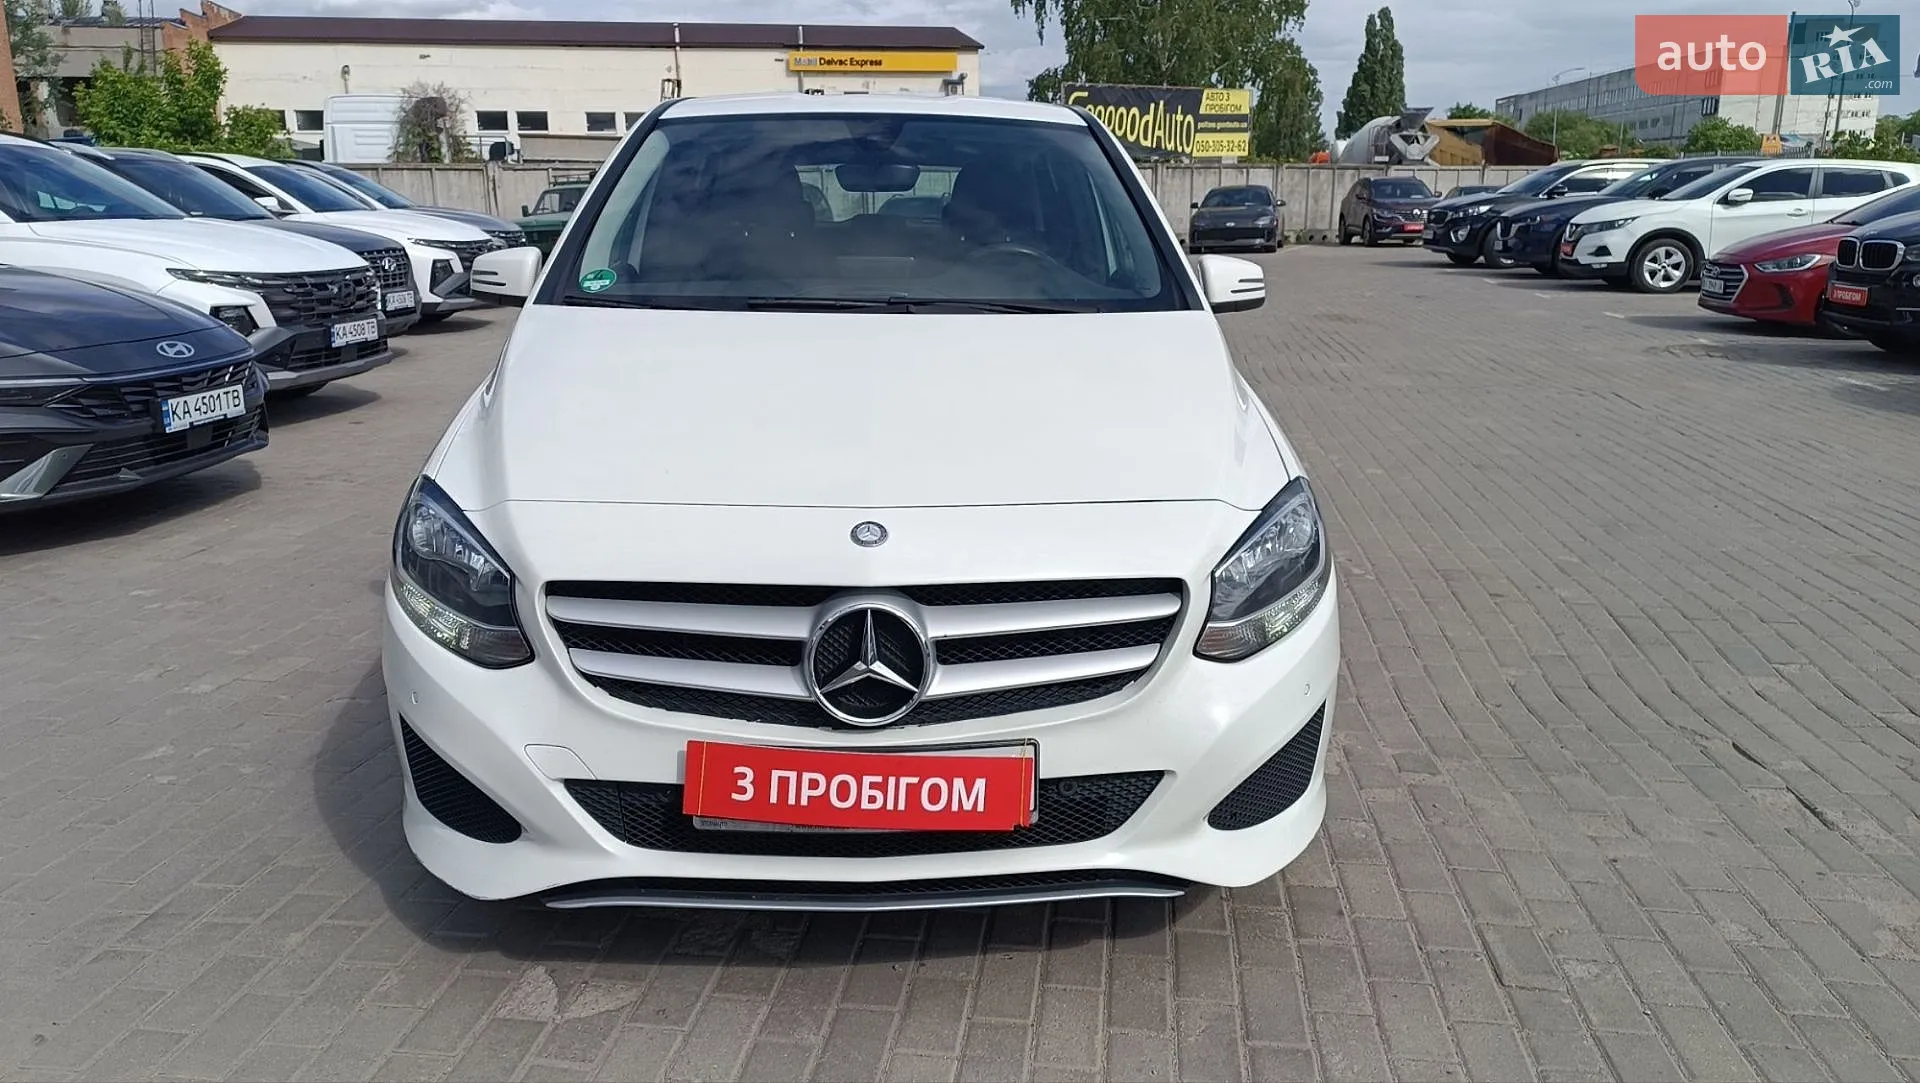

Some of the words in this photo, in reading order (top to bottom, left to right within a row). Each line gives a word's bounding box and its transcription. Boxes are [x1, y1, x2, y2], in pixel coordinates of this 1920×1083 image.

[819, 57, 848, 66] Delvac
[849, 57, 883, 68] Express
[170, 400, 192, 422] KA
[769, 769, 987, 813] ПРОБІГОМ
